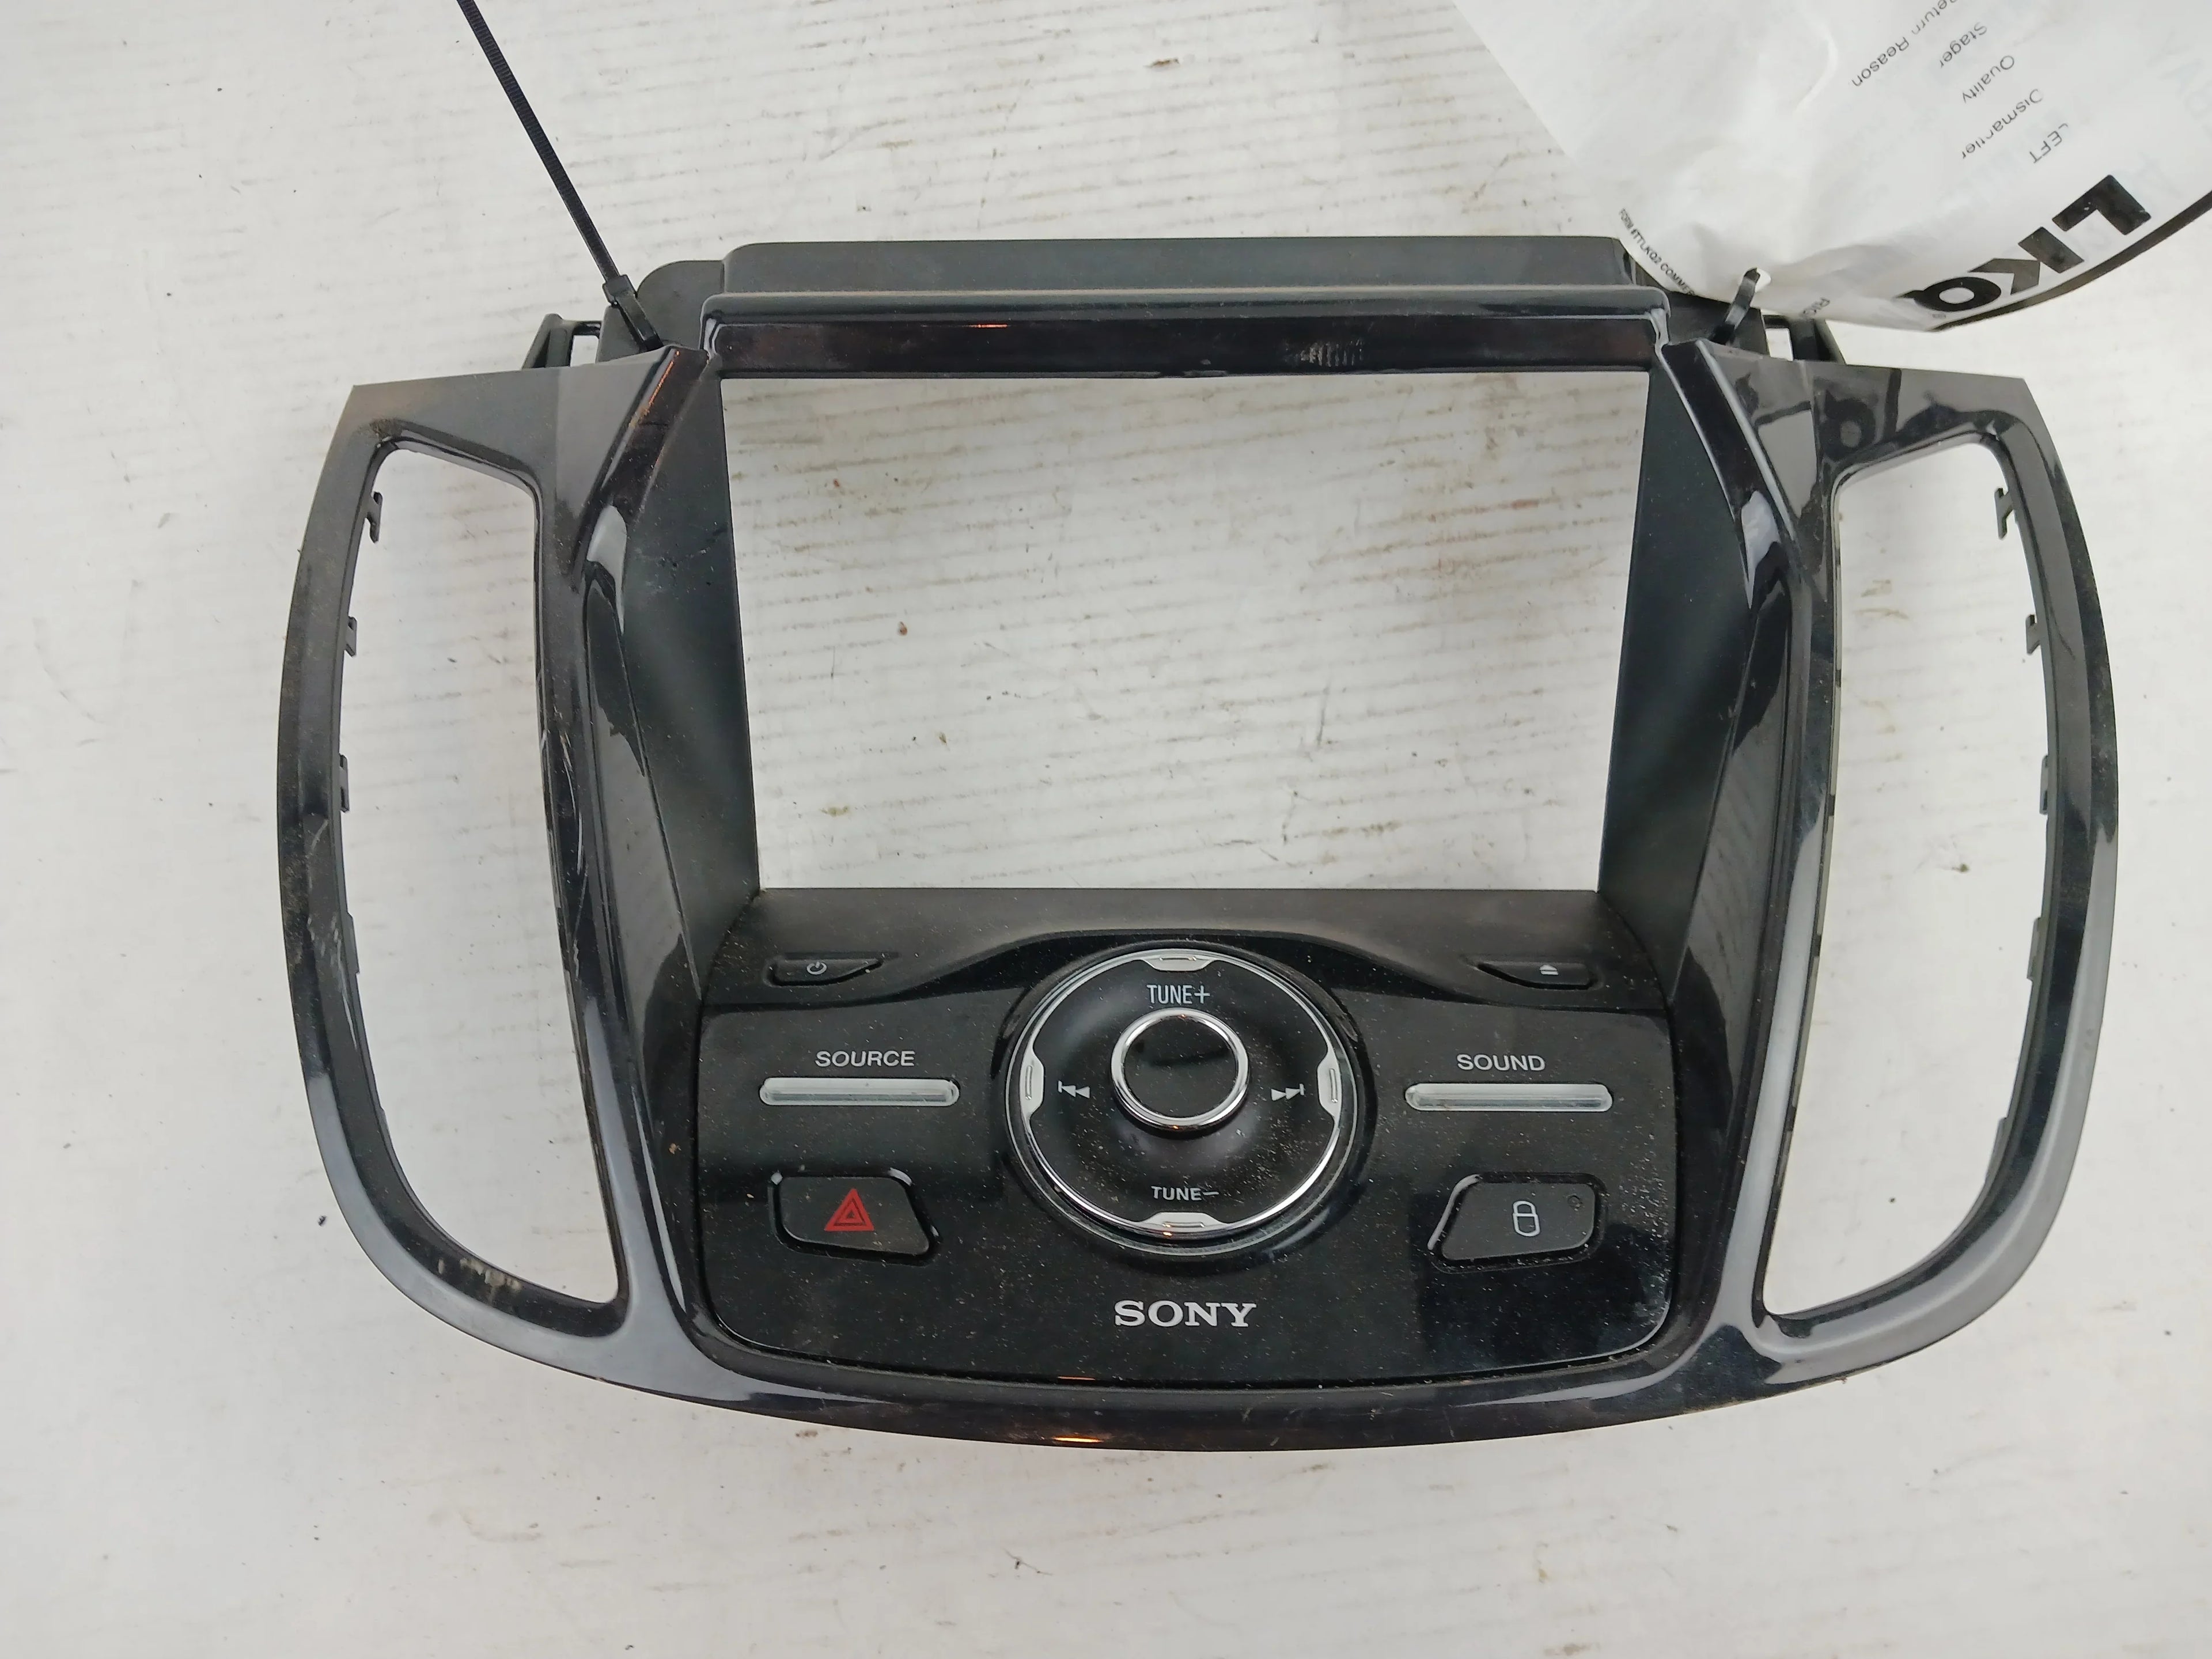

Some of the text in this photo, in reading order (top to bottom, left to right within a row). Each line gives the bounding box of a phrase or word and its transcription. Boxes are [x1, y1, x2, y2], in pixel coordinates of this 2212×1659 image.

[1851, 36, 1910, 87] Reason
[1938, 21, 1987, 69] Stager
[1961, 55, 2016, 104] Quality
[1895, 174, 2152, 312] LKQ
[815, 1050, 915, 1067] SOURCE
[1457, 1054, 1546, 1072] SOUND
[1114, 1300, 1257, 1328] SONY
